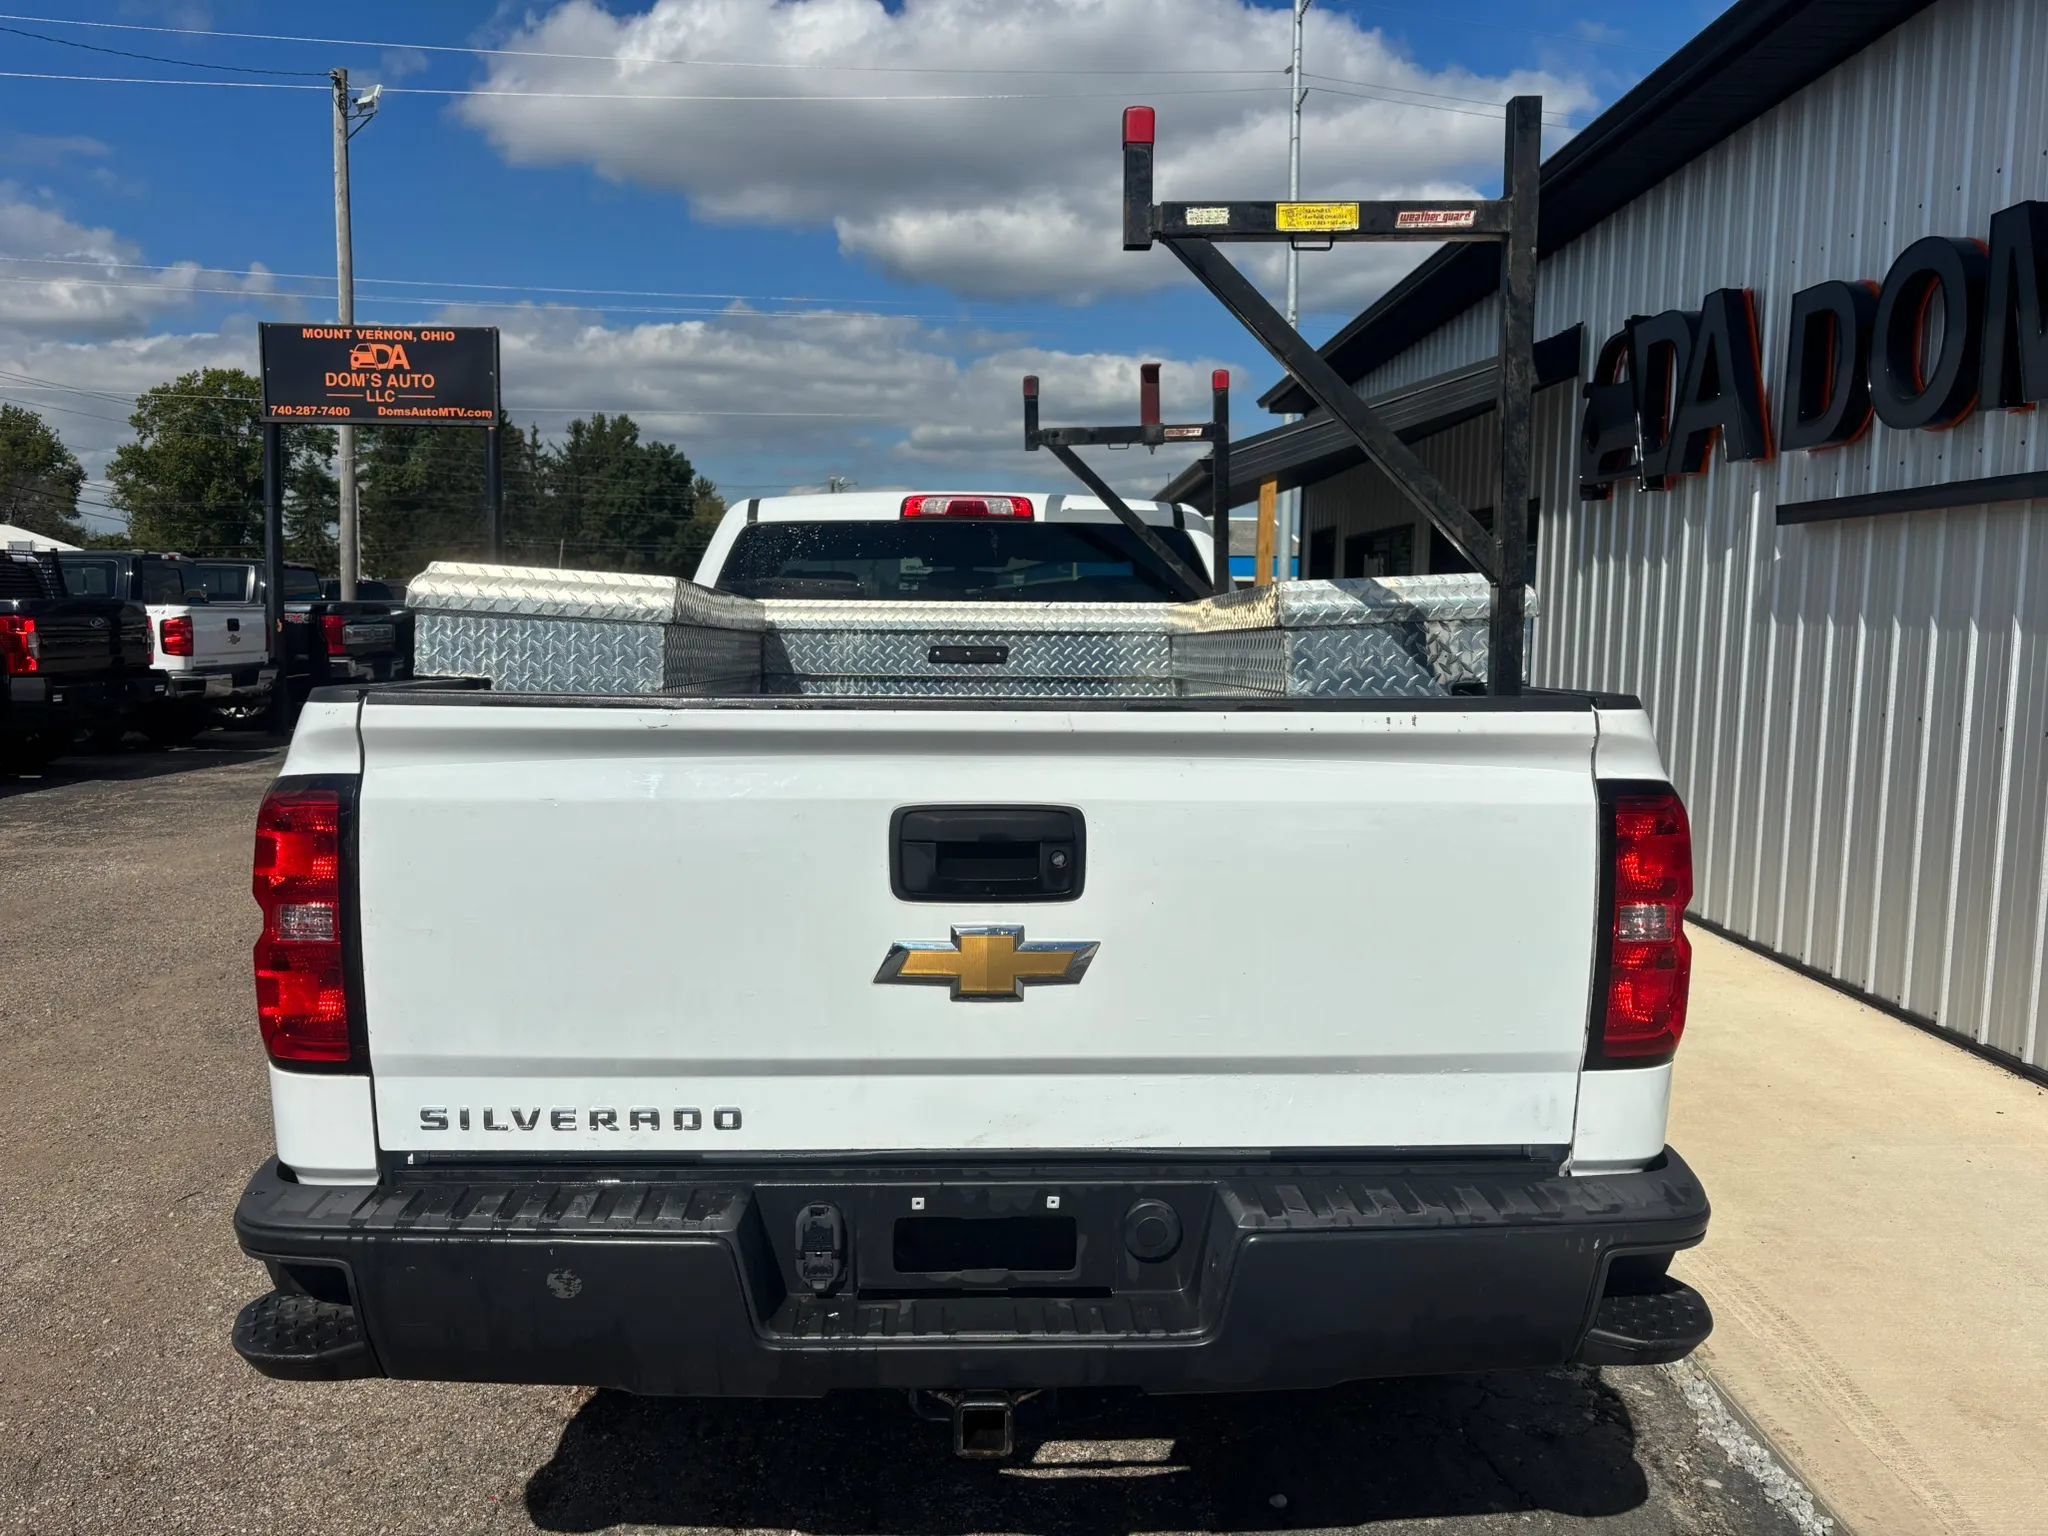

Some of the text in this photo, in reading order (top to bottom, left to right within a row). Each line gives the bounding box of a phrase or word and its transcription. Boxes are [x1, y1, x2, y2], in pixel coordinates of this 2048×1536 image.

[1400, 211, 1441, 222] weather
[302, 327, 456, 343] MOUNT VERNON, OHIO
[325, 372, 435, 388] DOM'S AUTO
[366, 389, 396, 403] LLC
[270, 405, 493, 418] 740-287-7400 DomsAutoMTV.com
[419, 1105, 743, 1132] SILVERADO
